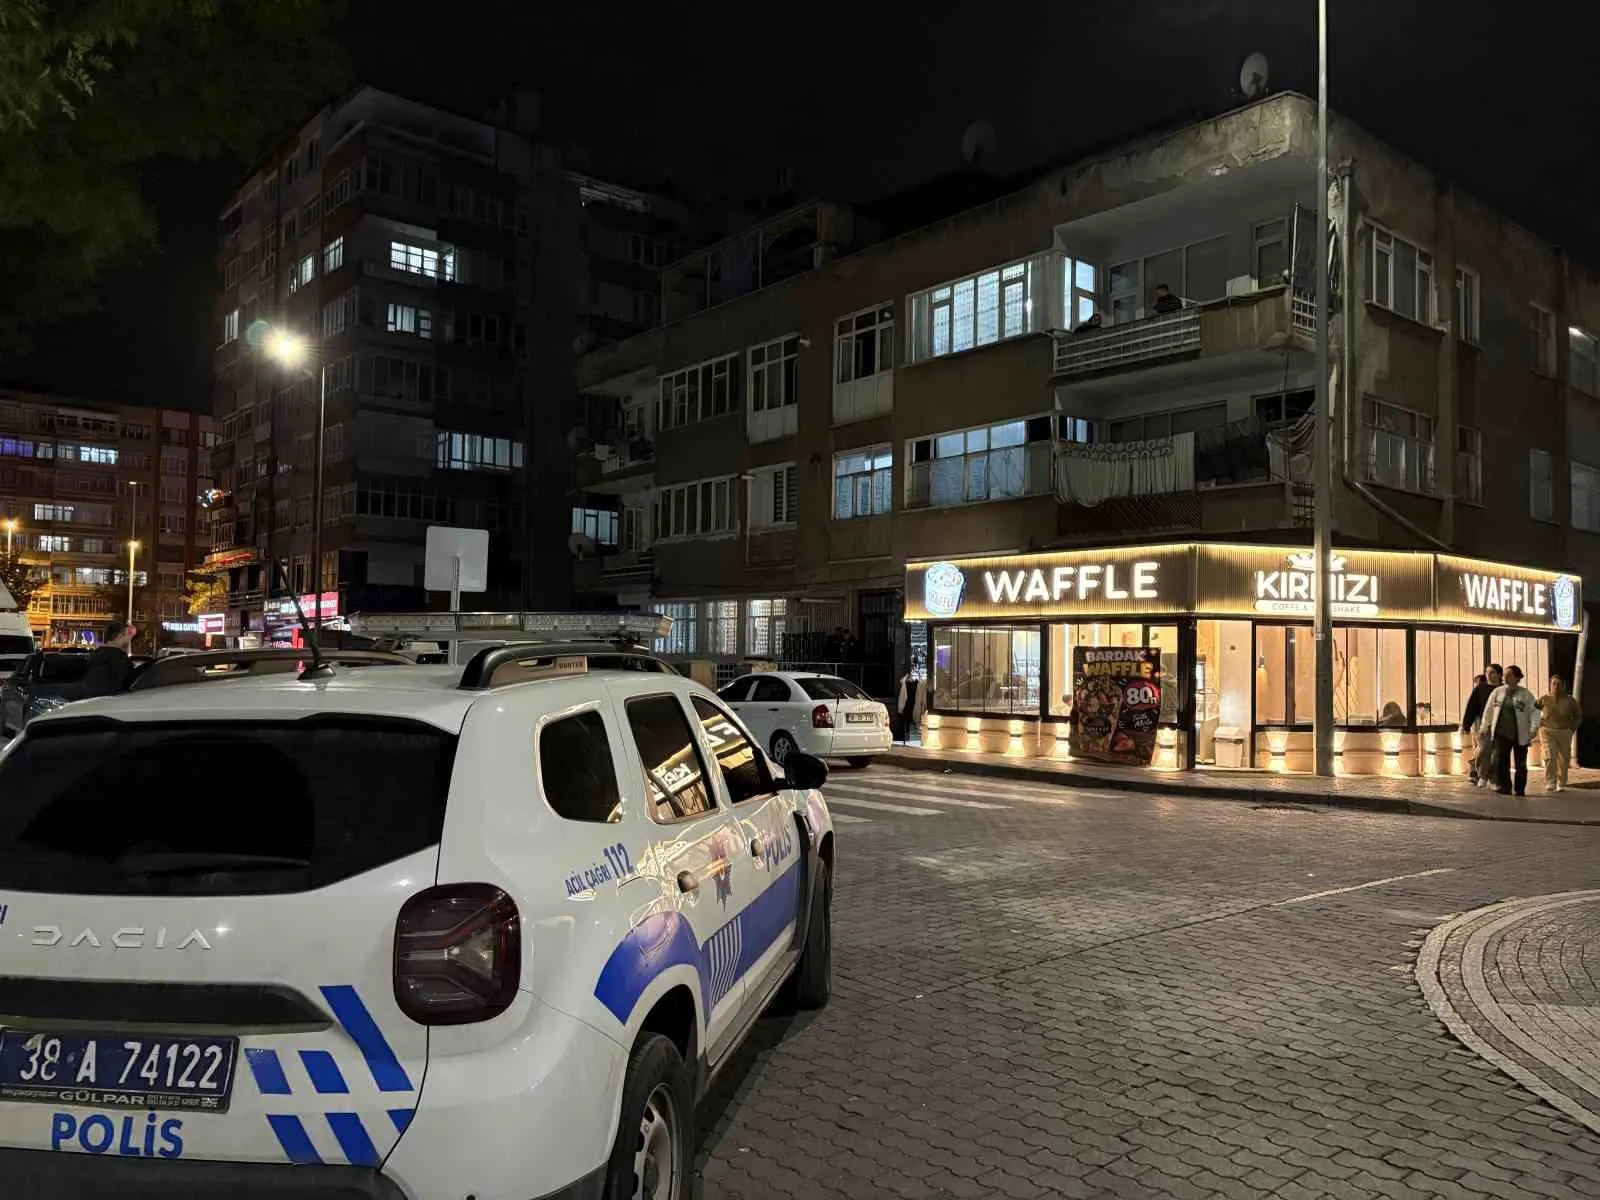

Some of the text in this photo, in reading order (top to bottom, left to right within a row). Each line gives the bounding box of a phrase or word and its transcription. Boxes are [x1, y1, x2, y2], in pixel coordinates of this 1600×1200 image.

[984, 562, 1159, 603] WAFFLE
[1463, 573, 1546, 615] WAFFLE
[1083, 661, 1154, 678] WAFFLE
[1085, 650, 1146, 662] BARDAK
[603, 842, 635, 879] 112
[31, 924, 213, 951] DACIA
[75, 1040, 98, 1083] A
[118, 1041, 224, 1089] 74122
[59, 1089, 145, 1106] GÜLPAR
[52, 1111, 184, 1160] POLİS
